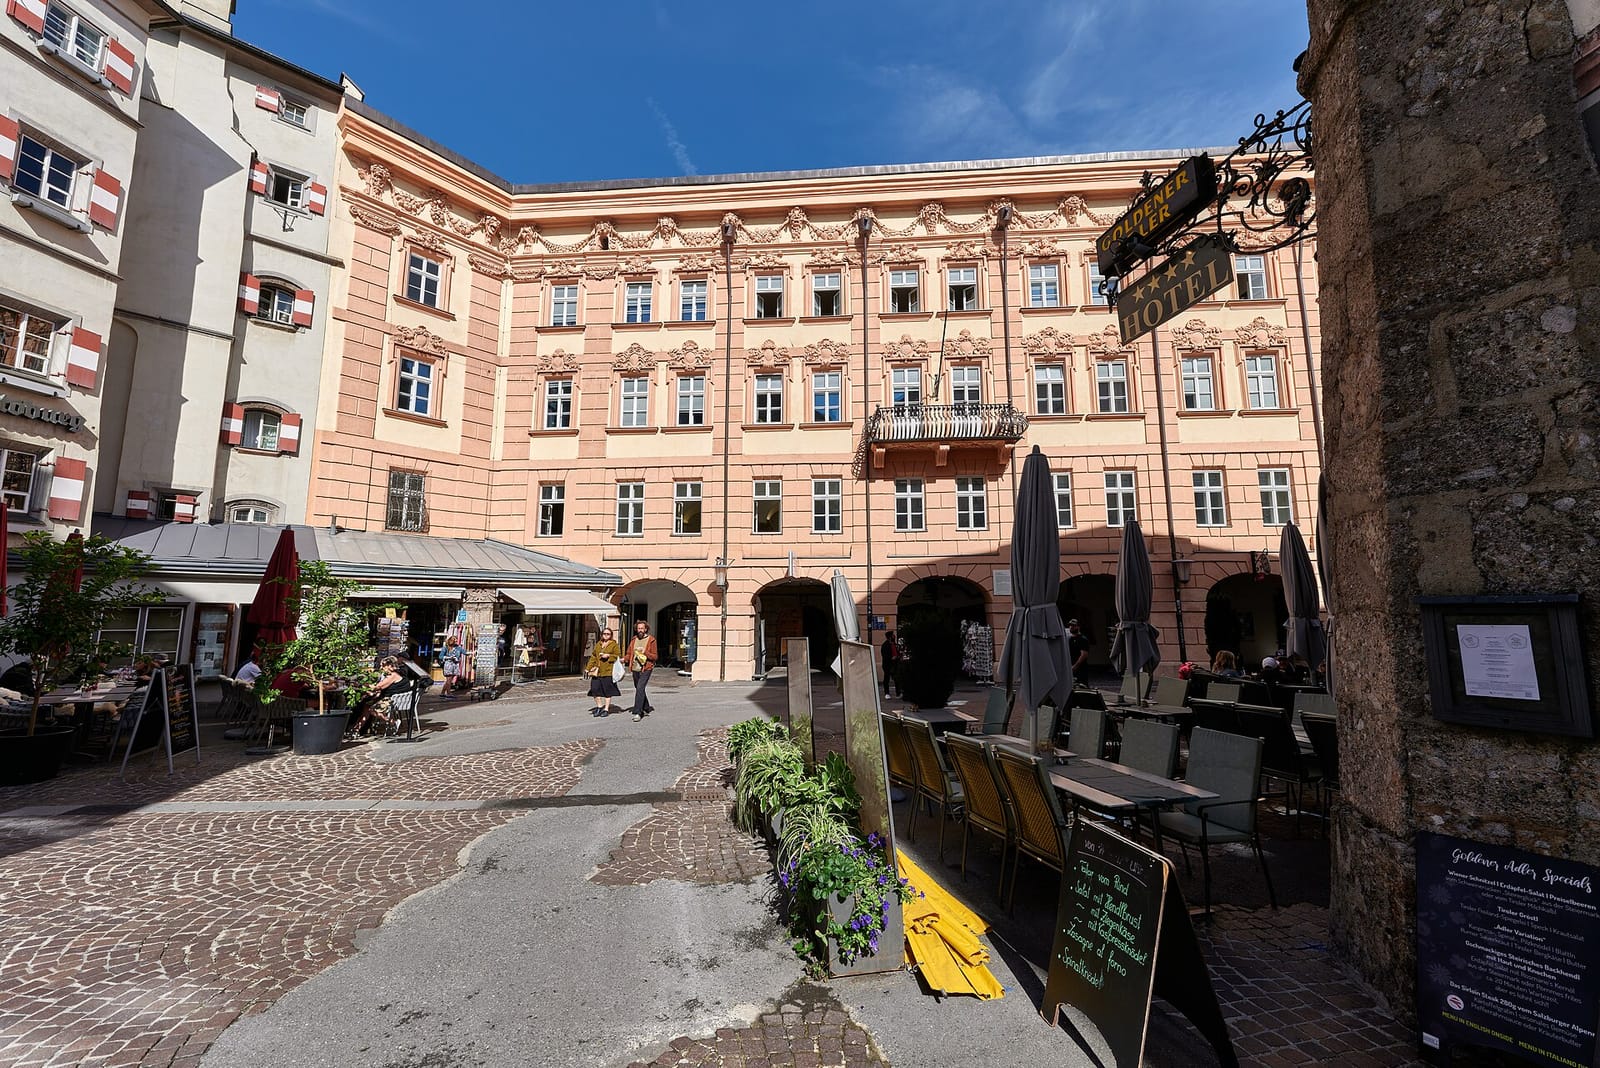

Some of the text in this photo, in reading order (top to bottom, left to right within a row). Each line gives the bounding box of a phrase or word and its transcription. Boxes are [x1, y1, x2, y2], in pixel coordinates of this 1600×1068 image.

[1101, 169, 1190, 251] GOLDENER
[1121, 259, 1229, 342] HOTEL
[1448, 870, 1468, 879] Wiener
[1469, 875, 1496, 886] Schnitzel
[1452, 848, 1592, 893] Goldener Adler Specials
[1497, 906, 1518, 916] Tiroler
[1067, 921, 1127, 976] Lasagne al forno
[1527, 966, 1556, 980] Knochen
[1544, 964, 1580, 980] Backhendl
[1533, 1010, 1570, 1028] Salzburger
[1546, 1051, 1577, 1068] ITALIANO
